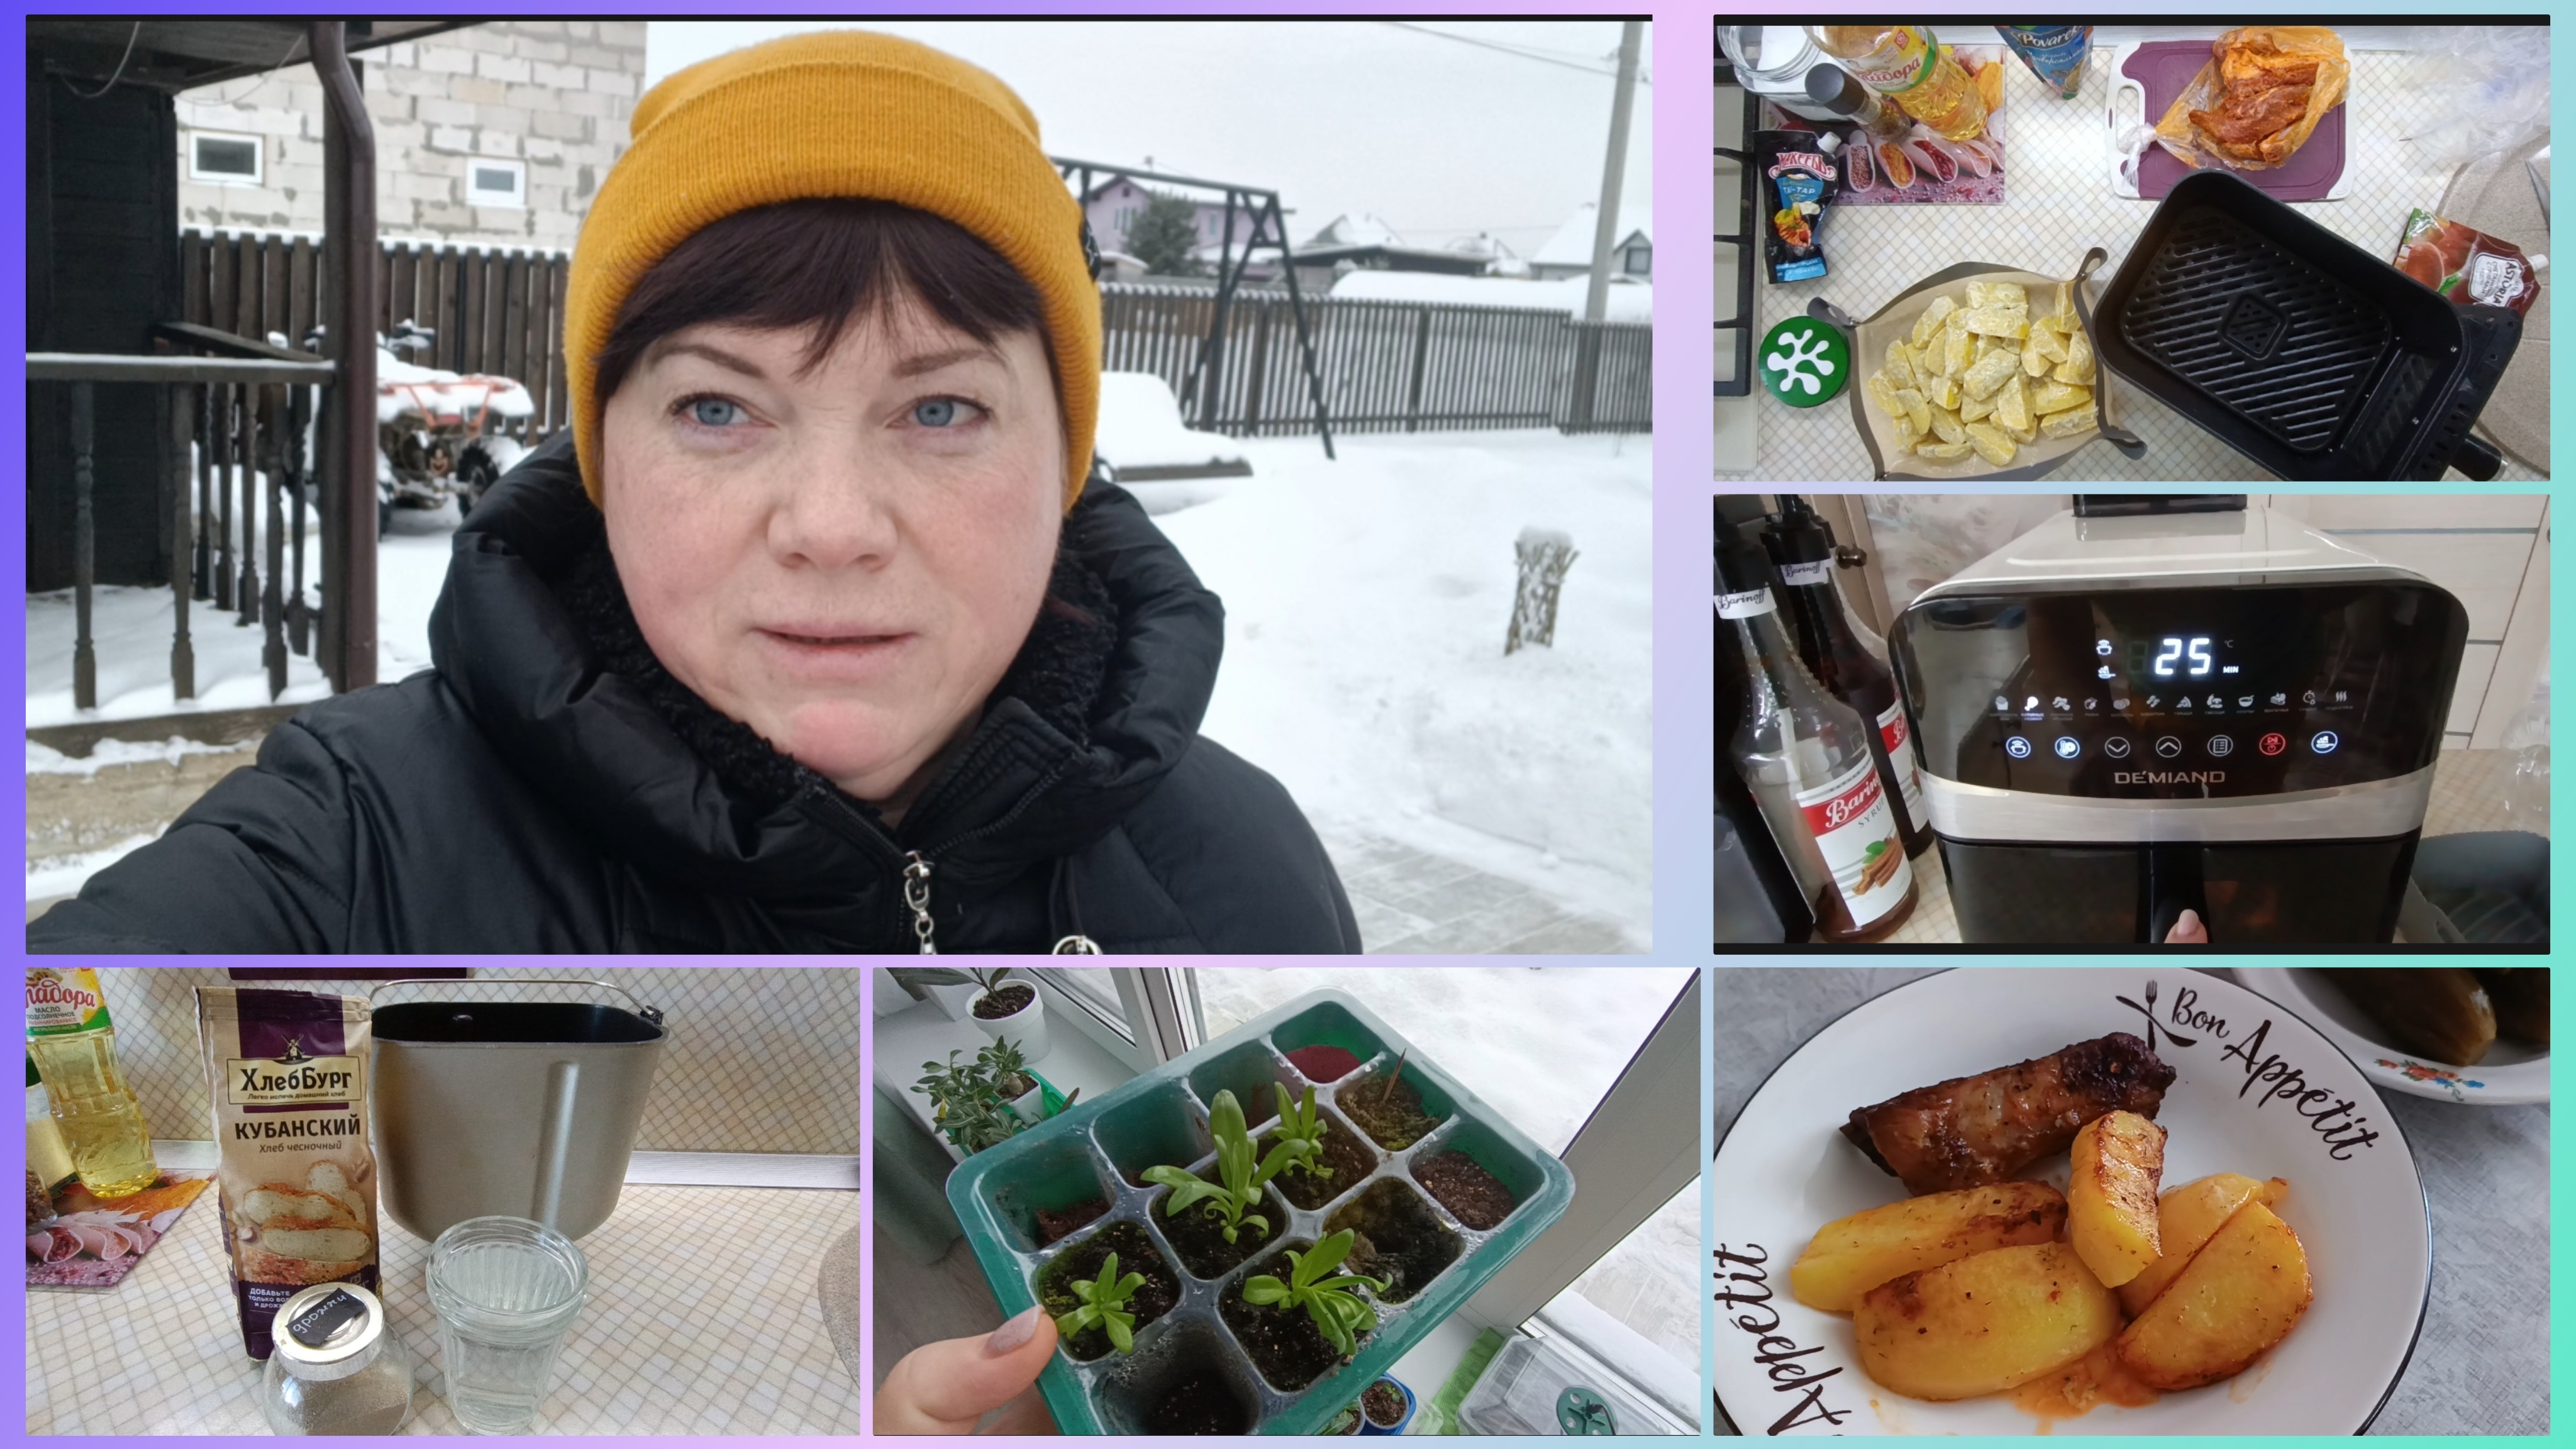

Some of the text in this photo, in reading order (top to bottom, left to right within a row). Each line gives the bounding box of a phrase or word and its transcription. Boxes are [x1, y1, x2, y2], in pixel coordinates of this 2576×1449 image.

[2018, 26, 2084, 47] Povarek
[2492, 261, 2516, 304] ASTORIA
[1785, 561, 1820, 577] Barinoff
[1718, 588, 1765, 610] Barinoff
[2155, 638, 2211, 675] 25
[1858, 797, 1884, 828] SYRUP
[26, 979, 96, 1011] ладора
[26, 1011, 75, 1020] ПОДСОЛНЕЧНОЕ
[2171, 987, 2230, 1039] Bon
[240, 1067, 352, 1092] ХлебБург
[235, 1113, 361, 1140] КУБАНСКИЙ
[259, 1141, 342, 1153] Хлеб чесночный
[250, 1287, 291, 1297] ДОБАВЬТЕ
